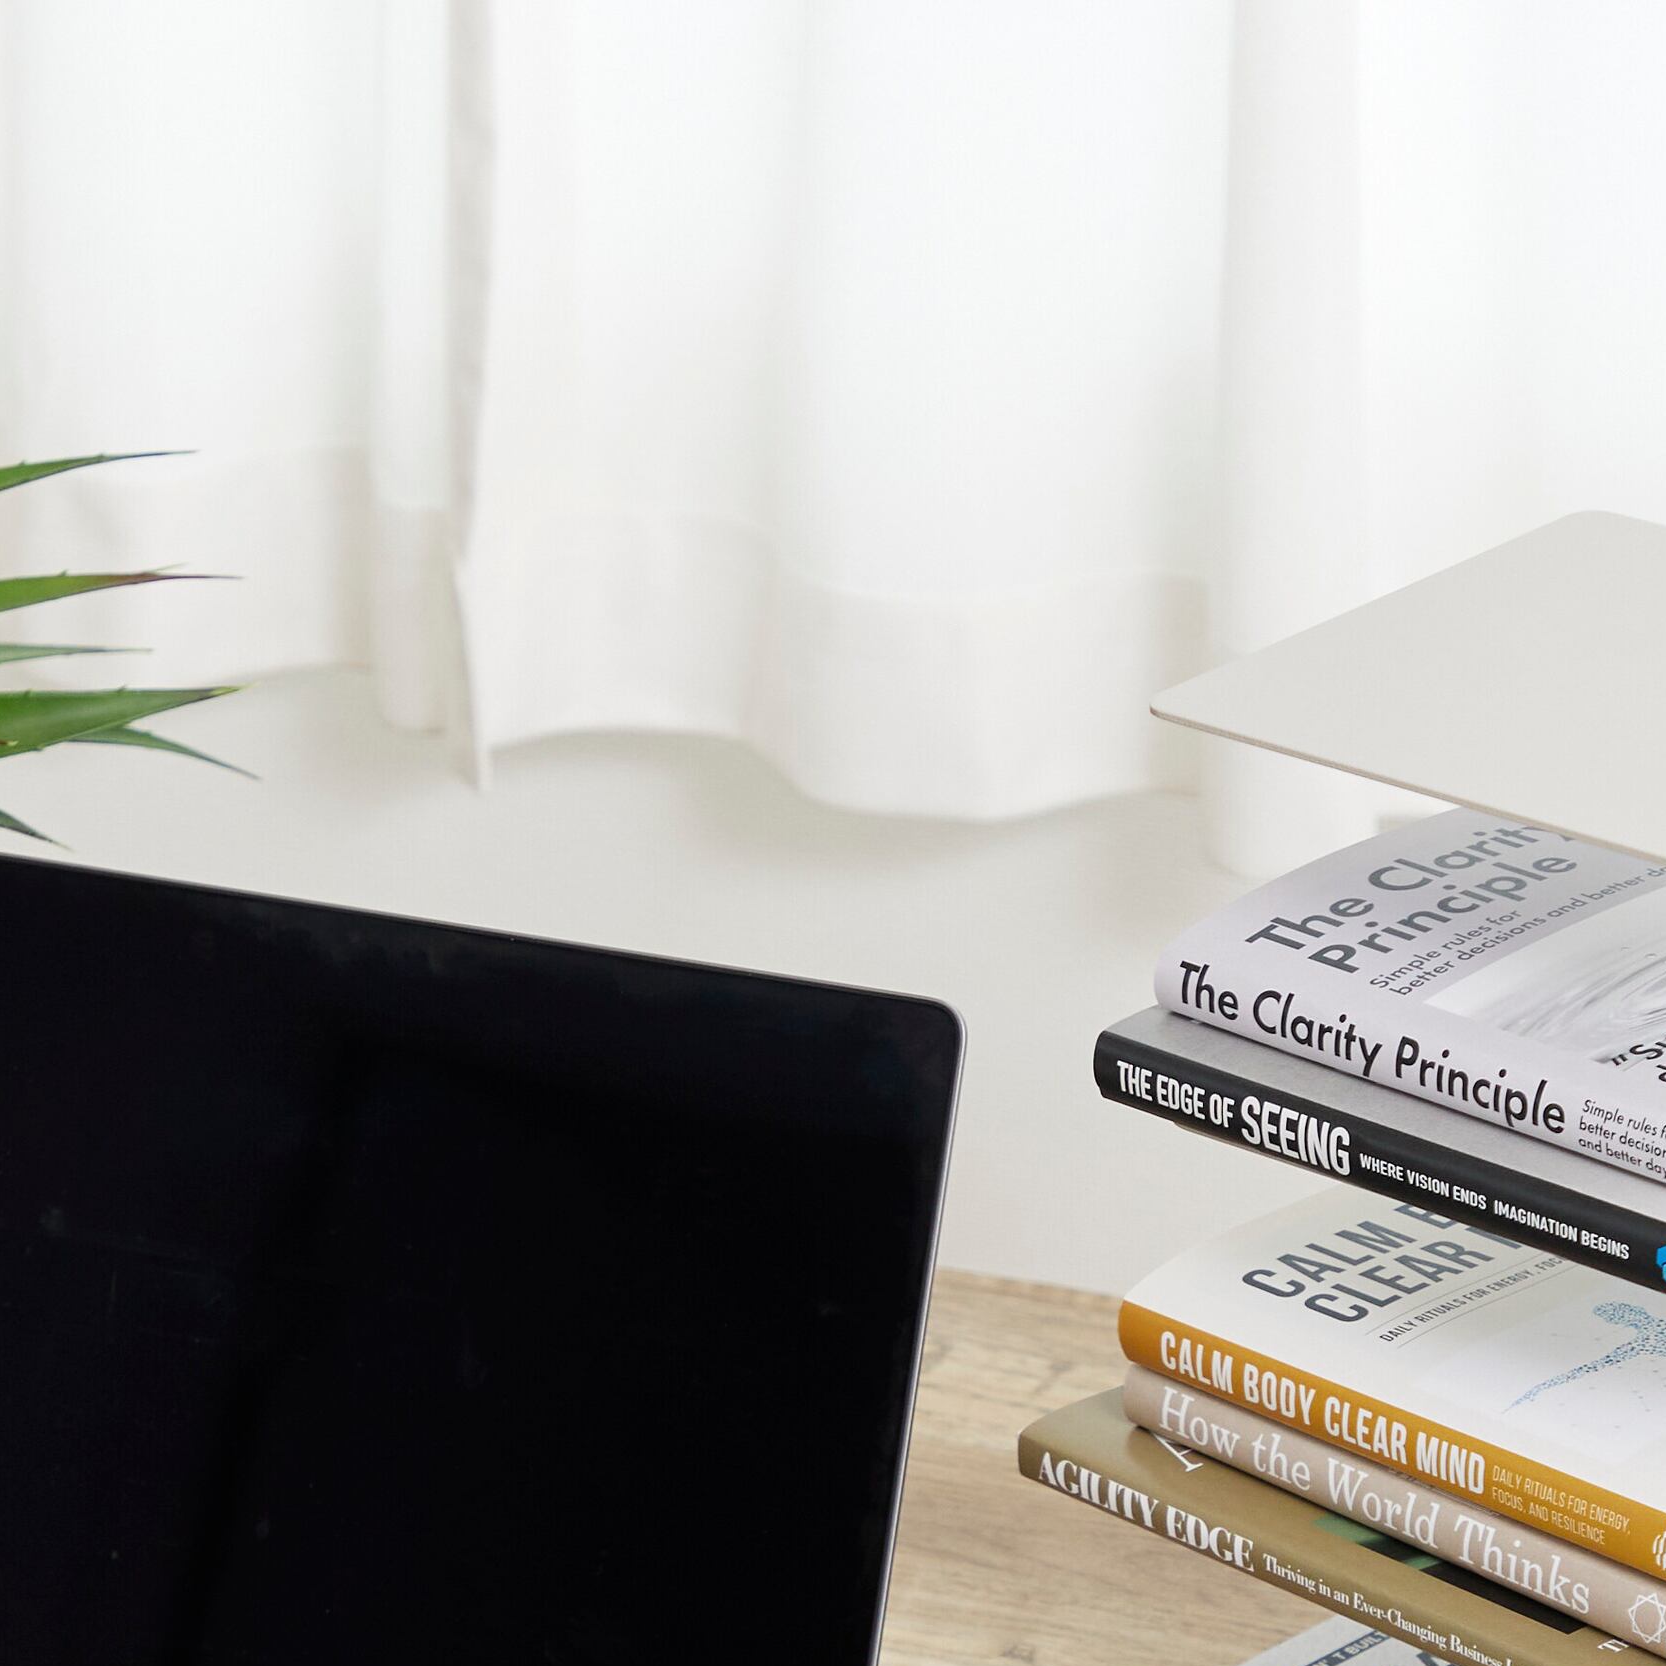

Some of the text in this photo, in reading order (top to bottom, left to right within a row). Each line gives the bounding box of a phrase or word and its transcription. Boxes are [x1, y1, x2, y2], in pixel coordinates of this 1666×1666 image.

[1246, 822, 1575, 950] The Clarit
[1308, 857, 1577, 974] Principle
[1389, 873, 1644, 996] better decisions and better
[1369, 908, 1523, 989] Simple rules for
[1179, 960, 1566, 1135] The Clarity Principle
[1116, 1059, 1351, 1177] THE EDGE OF SEEING
[1578, 1136, 1603, 1153] and
[1606, 1145, 1641, 1166] better
[1579, 1117, 1615, 1140] better
[1582, 1099, 1624, 1125] Simple
[1627, 1115, 1658, 1136] rules
[1360, 1154, 1630, 1260] WHERE VISION ENDS IMAGINATION BEGINS
[1242, 1220, 1414, 1298] CALM
[1304, 1239, 1494, 1323] CLEAR
[1160, 1330, 1485, 1495] CALM BODY CLEAR MIND
[1038, 1451, 1255, 1573] AGILITY EDGE
[1159, 1385, 1590, 1615] How the World Thinks
[1492, 1464, 1522, 1490] DAILY
[1523, 1476, 1565, 1508] RITUALS
[1568, 1495, 1587, 1516] FOR
[1527, 1502, 1549, 1523] AND
[1551, 1512, 1606, 1545] RESILIENCE
[1262, 1551, 1317, 1593] Thriving
[1318, 1578, 1332, 1599] in
[1333, 1587, 1350, 1605] an
[1353, 1592, 1447, 1651] Ever-Changing
